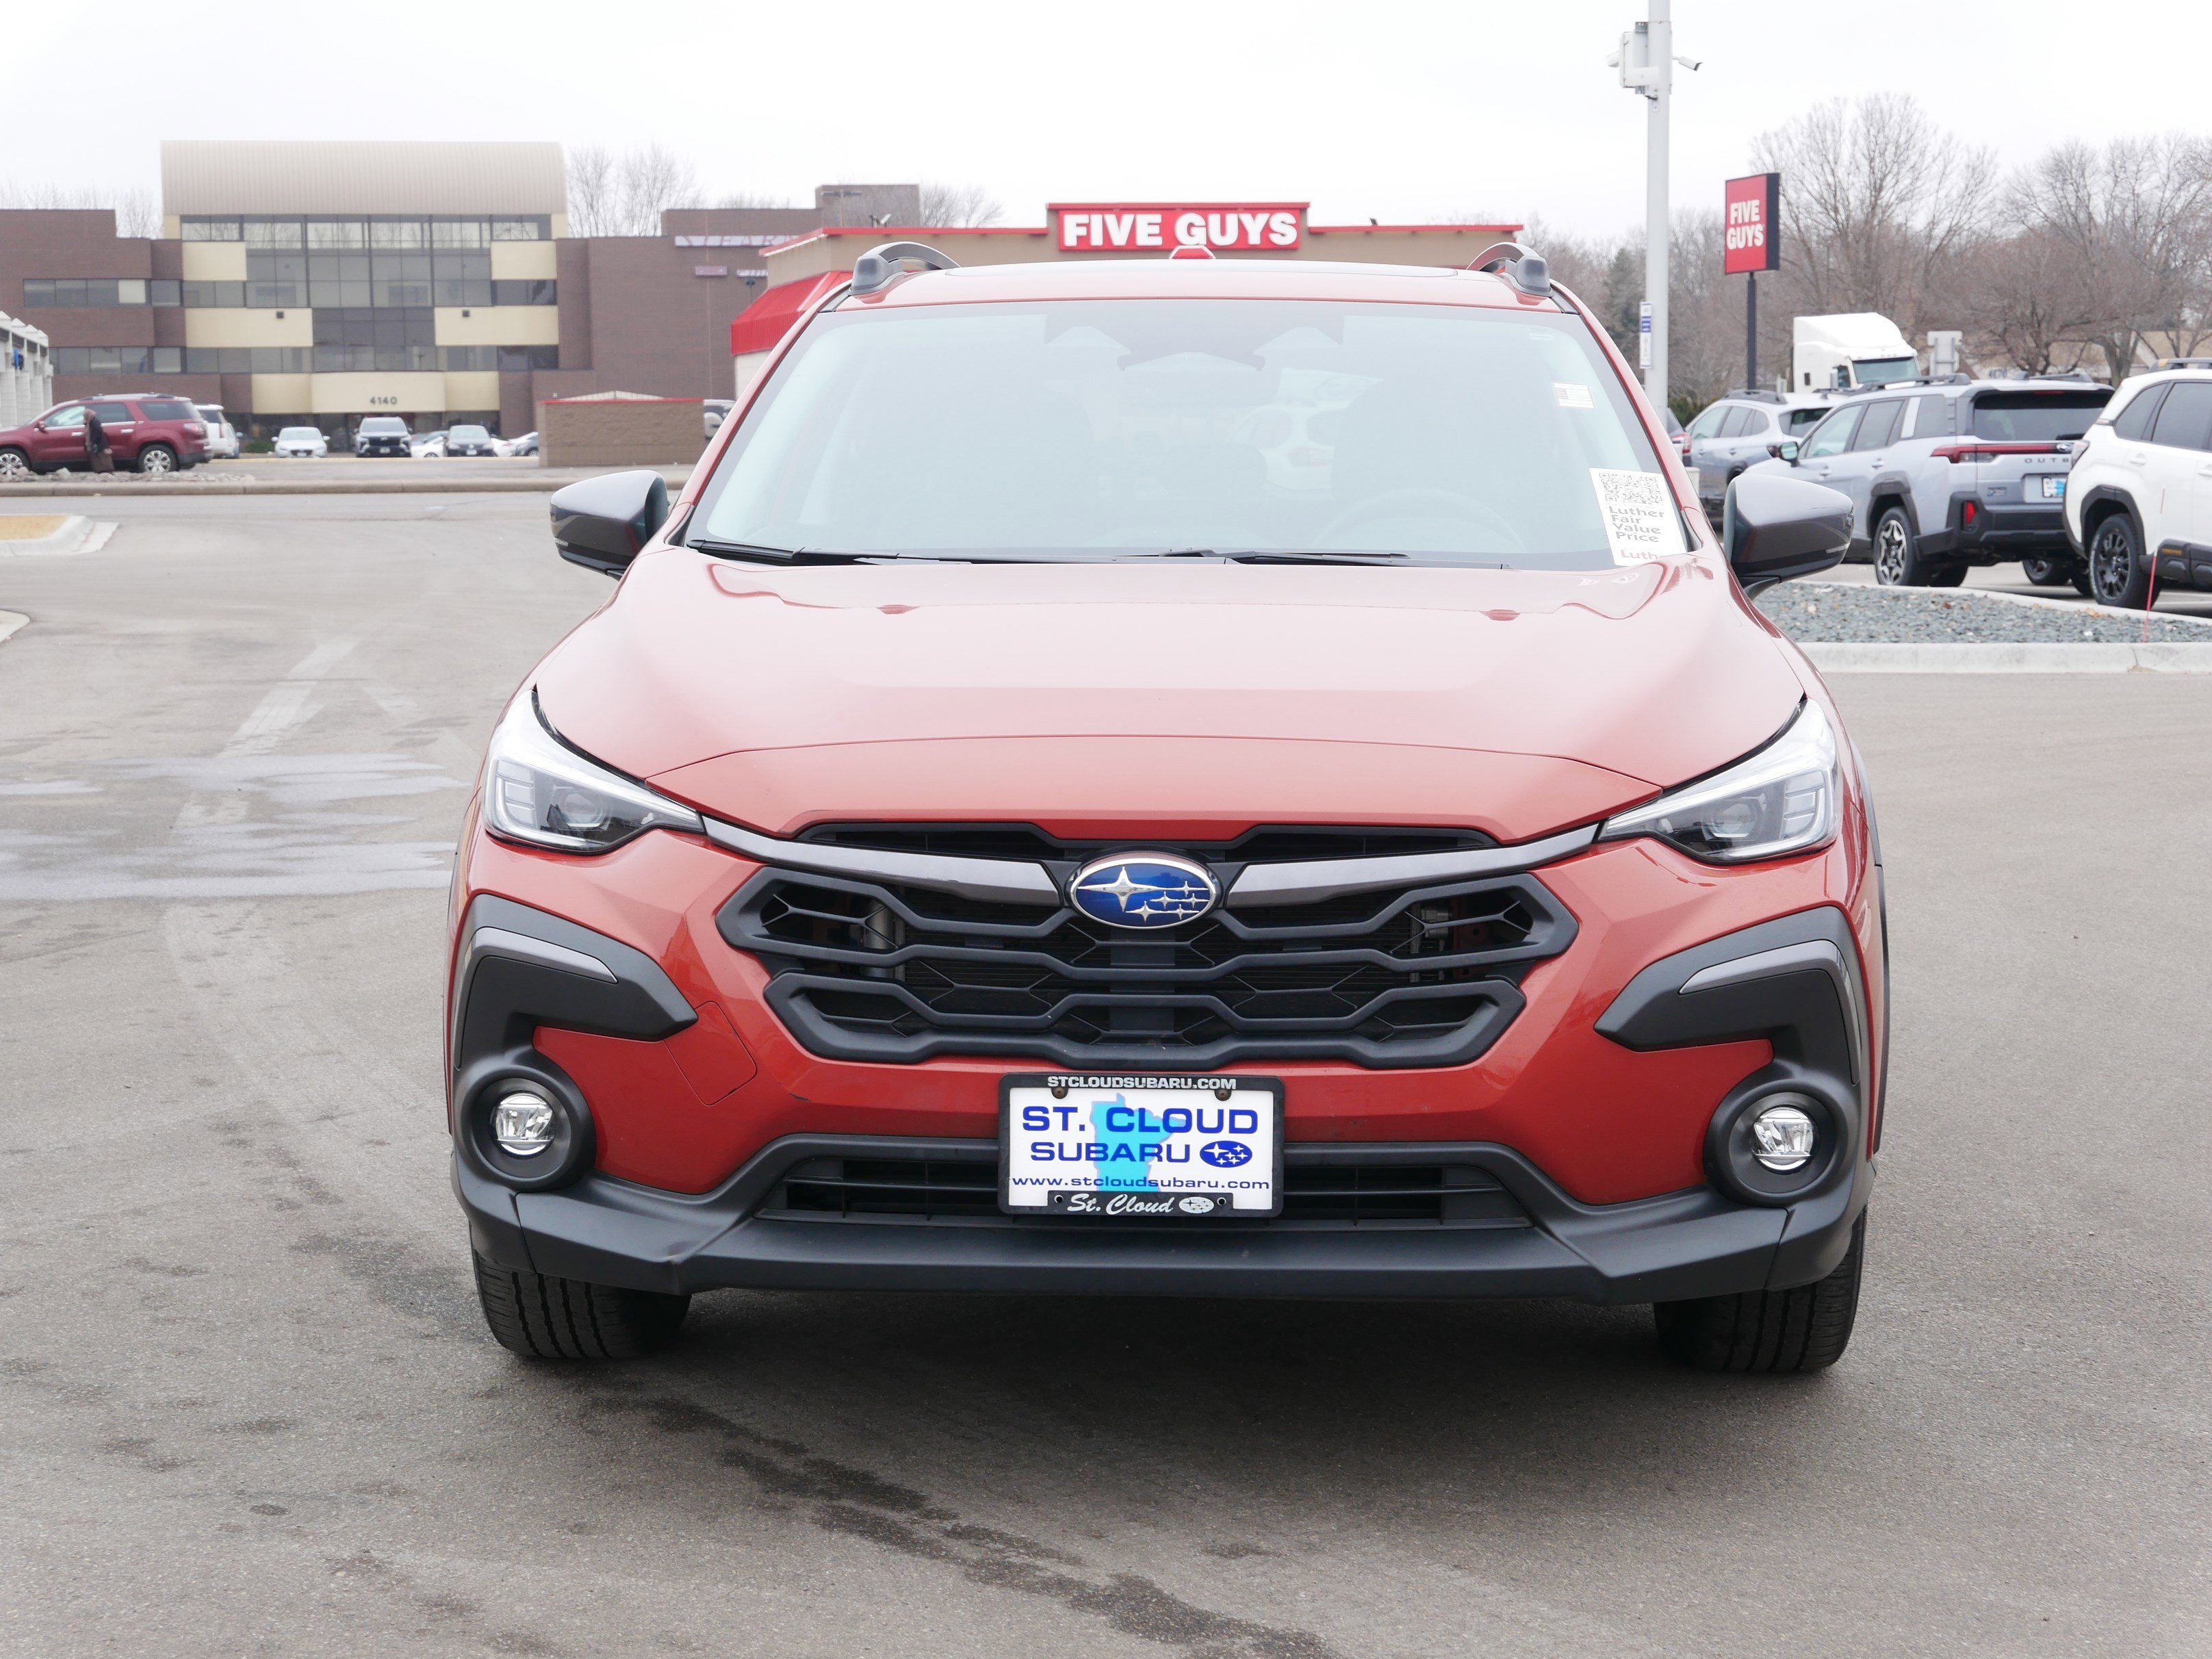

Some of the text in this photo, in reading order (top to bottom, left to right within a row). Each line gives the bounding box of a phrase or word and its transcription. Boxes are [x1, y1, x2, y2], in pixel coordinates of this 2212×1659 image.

[1729, 199, 1760, 225] FIVE
[1063, 212, 1298, 246] FIVE GUYS
[1727, 223, 1764, 250] GUYS
[370, 396, 398, 404] 4140
[1609, 506, 1664, 517] Luther
[1611, 514, 1641, 524] Fair
[1612, 522, 1661, 534] Value
[1615, 531, 1659, 543] Price
[1621, 550, 1664, 560] Luth
[1047, 1076, 1237, 1090] STCLOUDSUBARU.COM
[1022, 1106, 1258, 1134] ST. CLOUD
[1031, 1142, 1190, 1163] SUBARU
[1012, 1176, 1270, 1189] www.stcloudsubaru.com
[1067, 1193, 1174, 1215] St. Cloud
